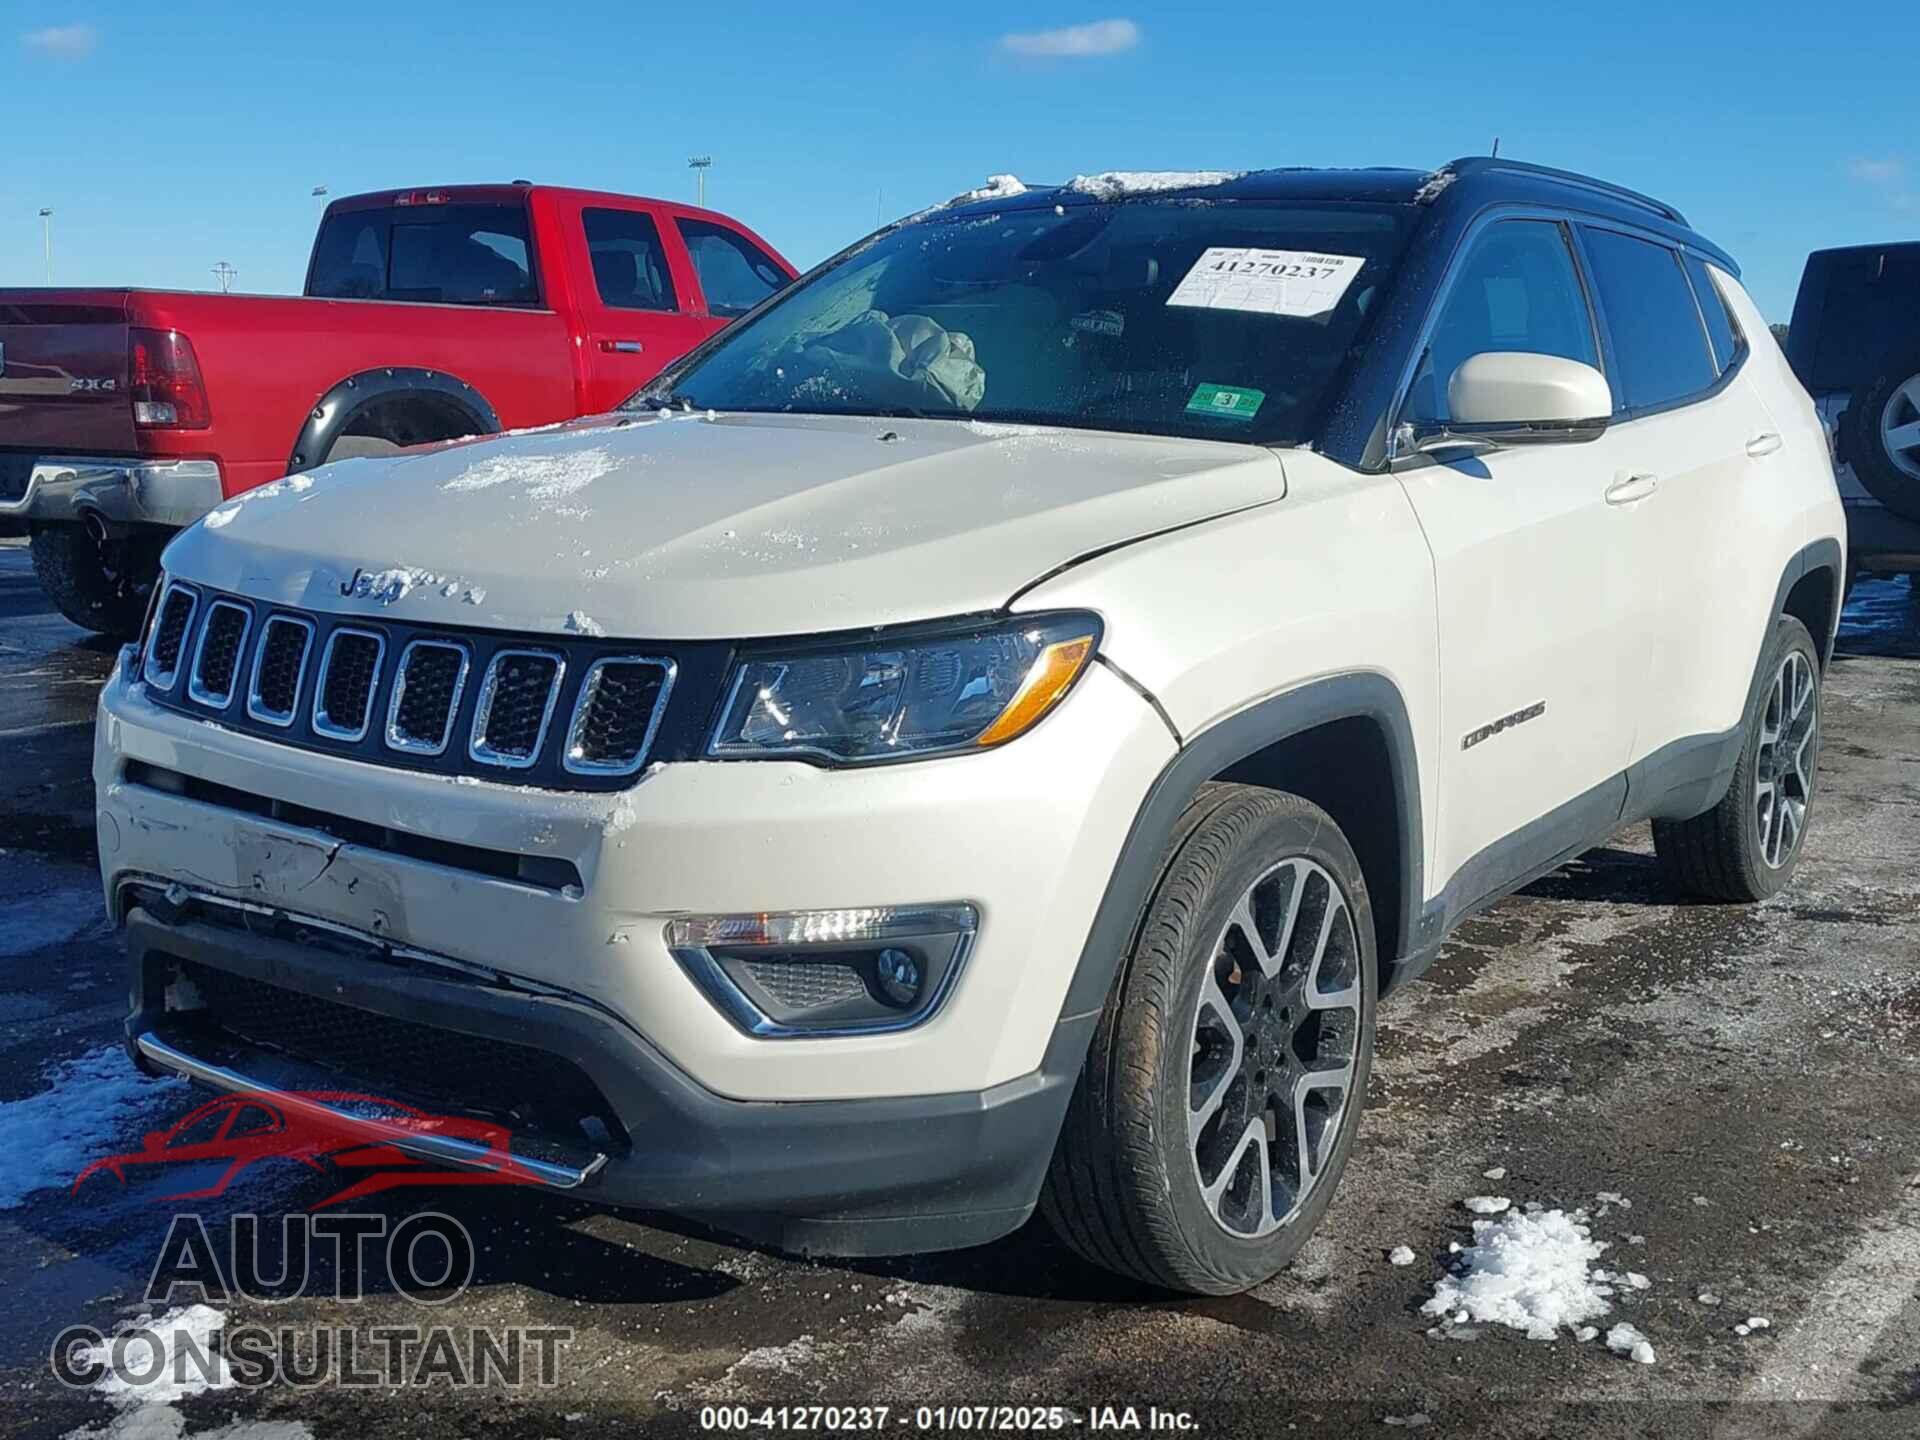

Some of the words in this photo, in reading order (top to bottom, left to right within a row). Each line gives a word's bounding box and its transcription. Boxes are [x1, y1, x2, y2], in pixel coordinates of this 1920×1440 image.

[1208, 259, 1336, 280] 41270237
[1220, 392, 1233, 406] 3
[1461, 699, 1547, 752] COMPASS
